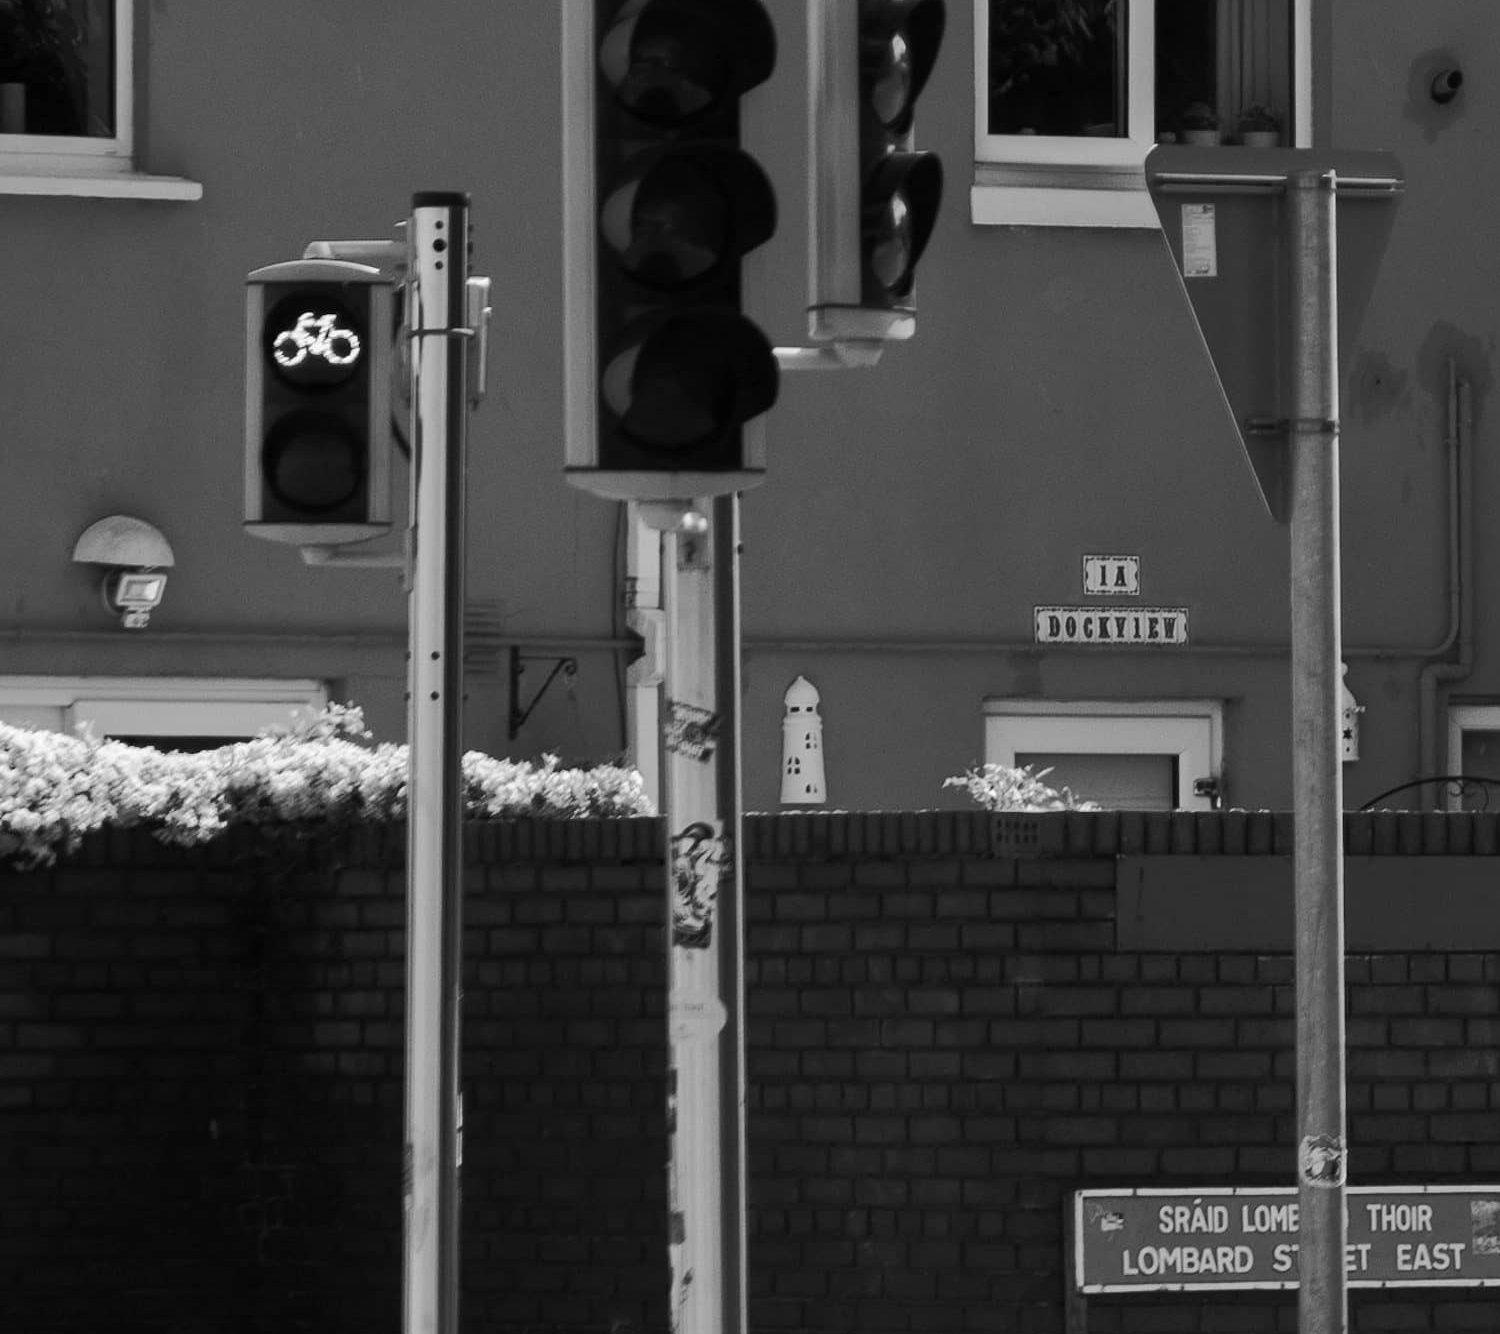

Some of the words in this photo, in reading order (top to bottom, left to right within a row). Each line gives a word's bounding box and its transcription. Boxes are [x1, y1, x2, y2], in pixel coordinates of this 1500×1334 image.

[1048, 615, 1177, 639] DOCKVIEW
[1159, 1197, 1229, 1234] SRÁID
[1366, 1203, 1433, 1232] THOIR
[1123, 1245, 1254, 1276] LOMBARD
[1396, 1242, 1466, 1271] EAST
